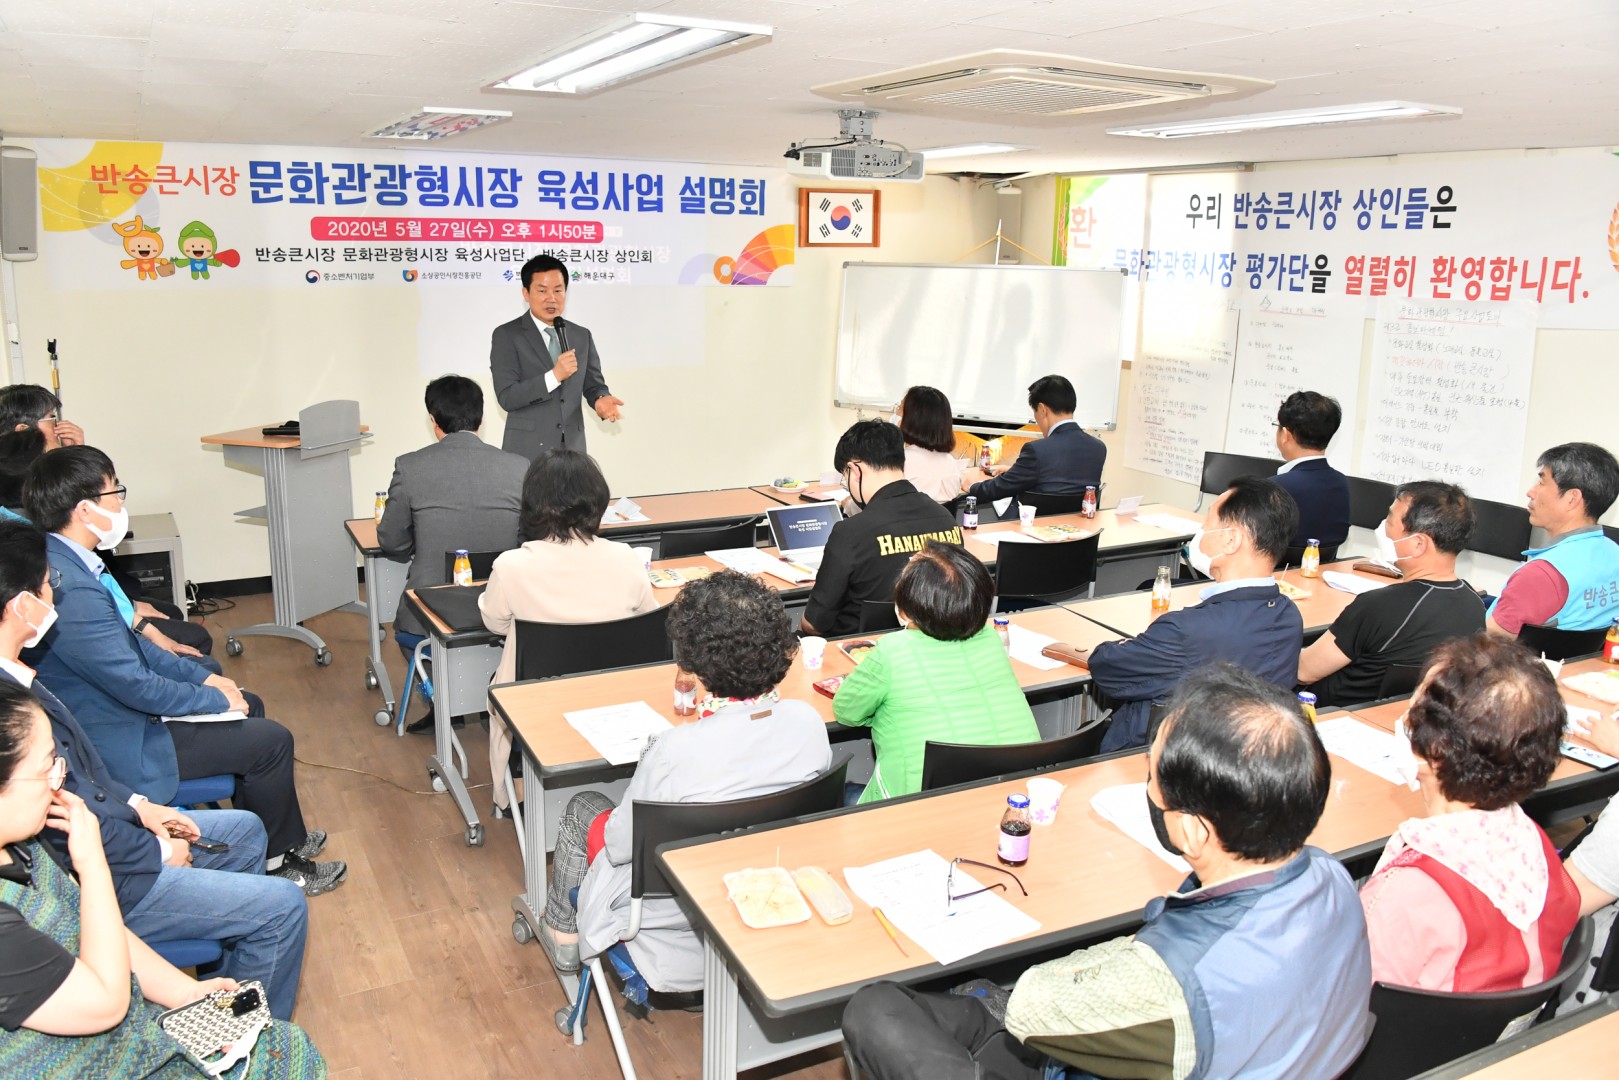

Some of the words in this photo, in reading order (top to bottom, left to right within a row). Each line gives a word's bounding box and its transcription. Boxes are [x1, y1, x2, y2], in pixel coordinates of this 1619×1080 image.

[91, 163, 240, 196] 반송큰시장
[249, 160, 523, 208] 문화관광형시장
[537, 169, 664, 213] 육성사업
[678, 175, 766, 216] 설명회
[1186, 193, 1222, 229] 우리
[1233, 189, 1342, 231] 반송큰시장
[1353, 185, 1457, 231] 상인들은
[328, 221, 388, 237] 2020년
[396, 221, 422, 237] 5월
[429, 221, 495, 239] 27일(수)
[501, 222, 532, 238] 오후
[539, 224, 597, 240] 1시50분
[255, 247, 336, 263] 반송큰시장
[342, 247, 449, 262] 문화관광형시장
[542, 249, 609, 263] 반송큰시장
[615, 249, 653, 264] 상인회
[323, 272, 375, 281] 중소벤처기업부
[584, 271, 615, 280] 해운대구
[1246, 253, 1331, 294] 평가단을
[1344, 255, 1417, 298] 열렬히
[1430, 255, 1589, 304] 환영합니다.
